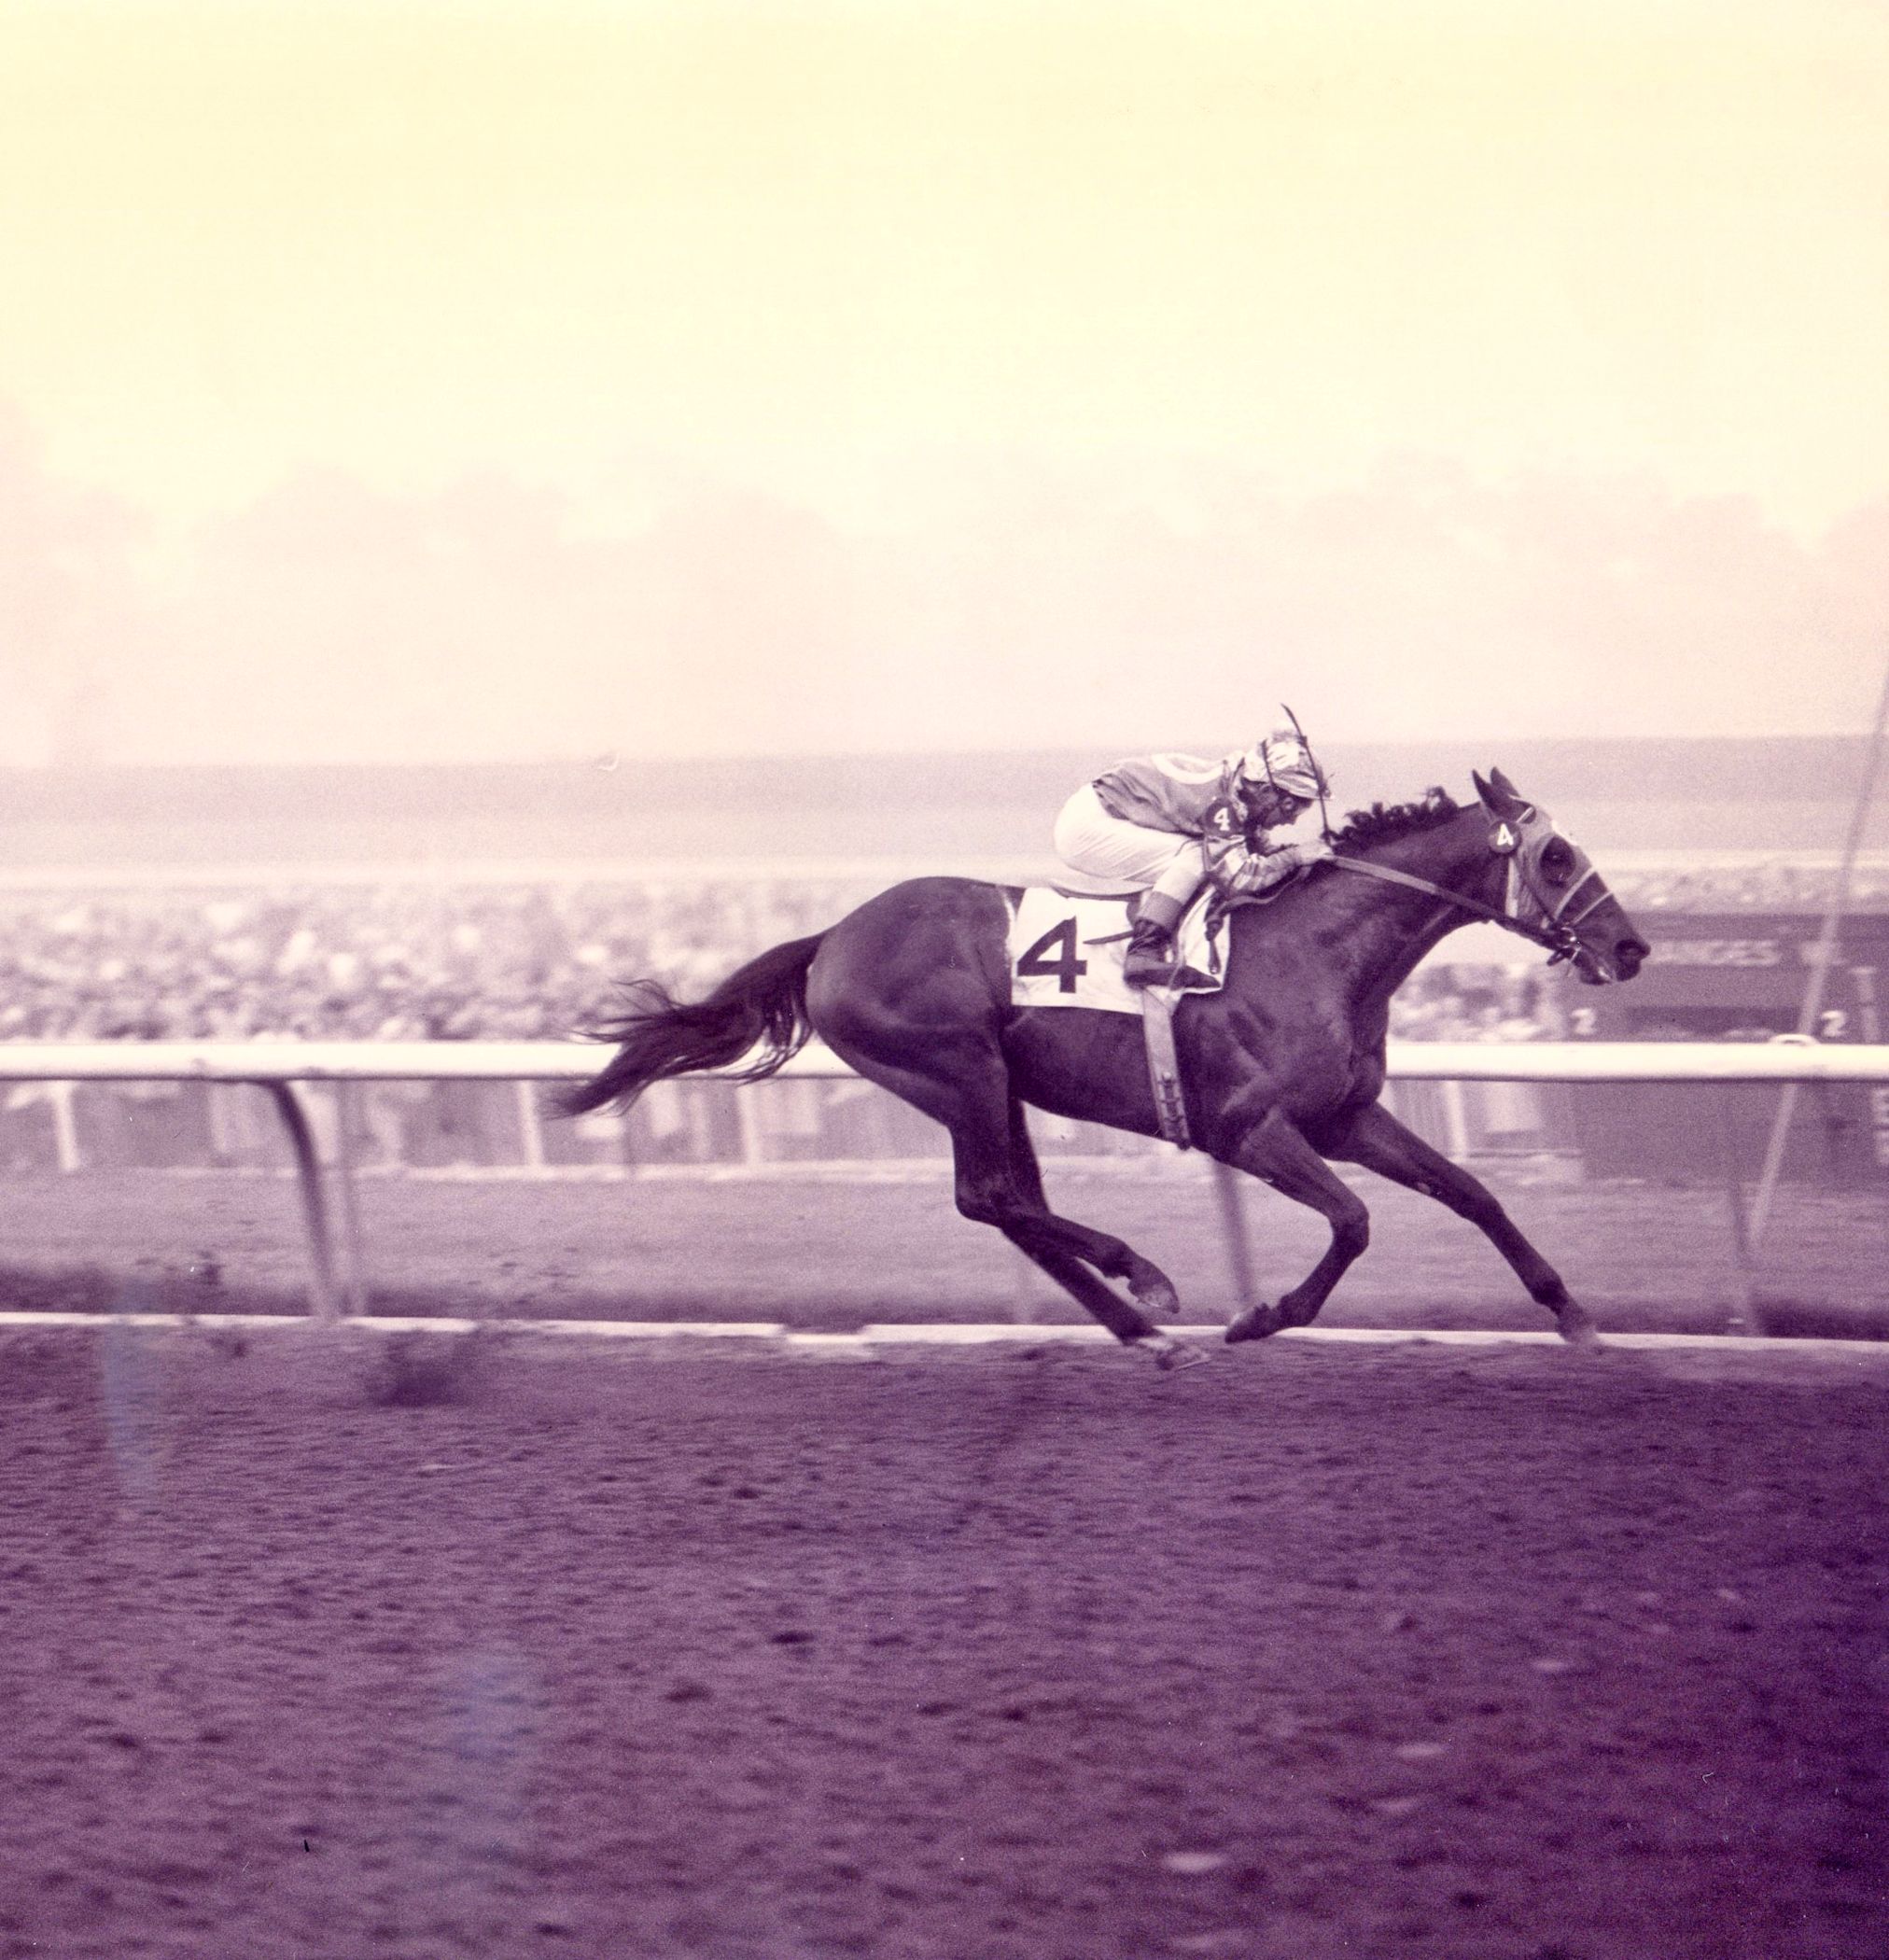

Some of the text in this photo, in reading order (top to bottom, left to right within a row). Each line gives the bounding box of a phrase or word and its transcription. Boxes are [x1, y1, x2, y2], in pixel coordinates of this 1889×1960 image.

[1213, 806, 1230, 831] 4
[1496, 822, 1515, 846] 4
[1017, 915, 1087, 994] 4
[1571, 1008, 1596, 1035] 2
[1821, 1009, 1849, 1037] 2
